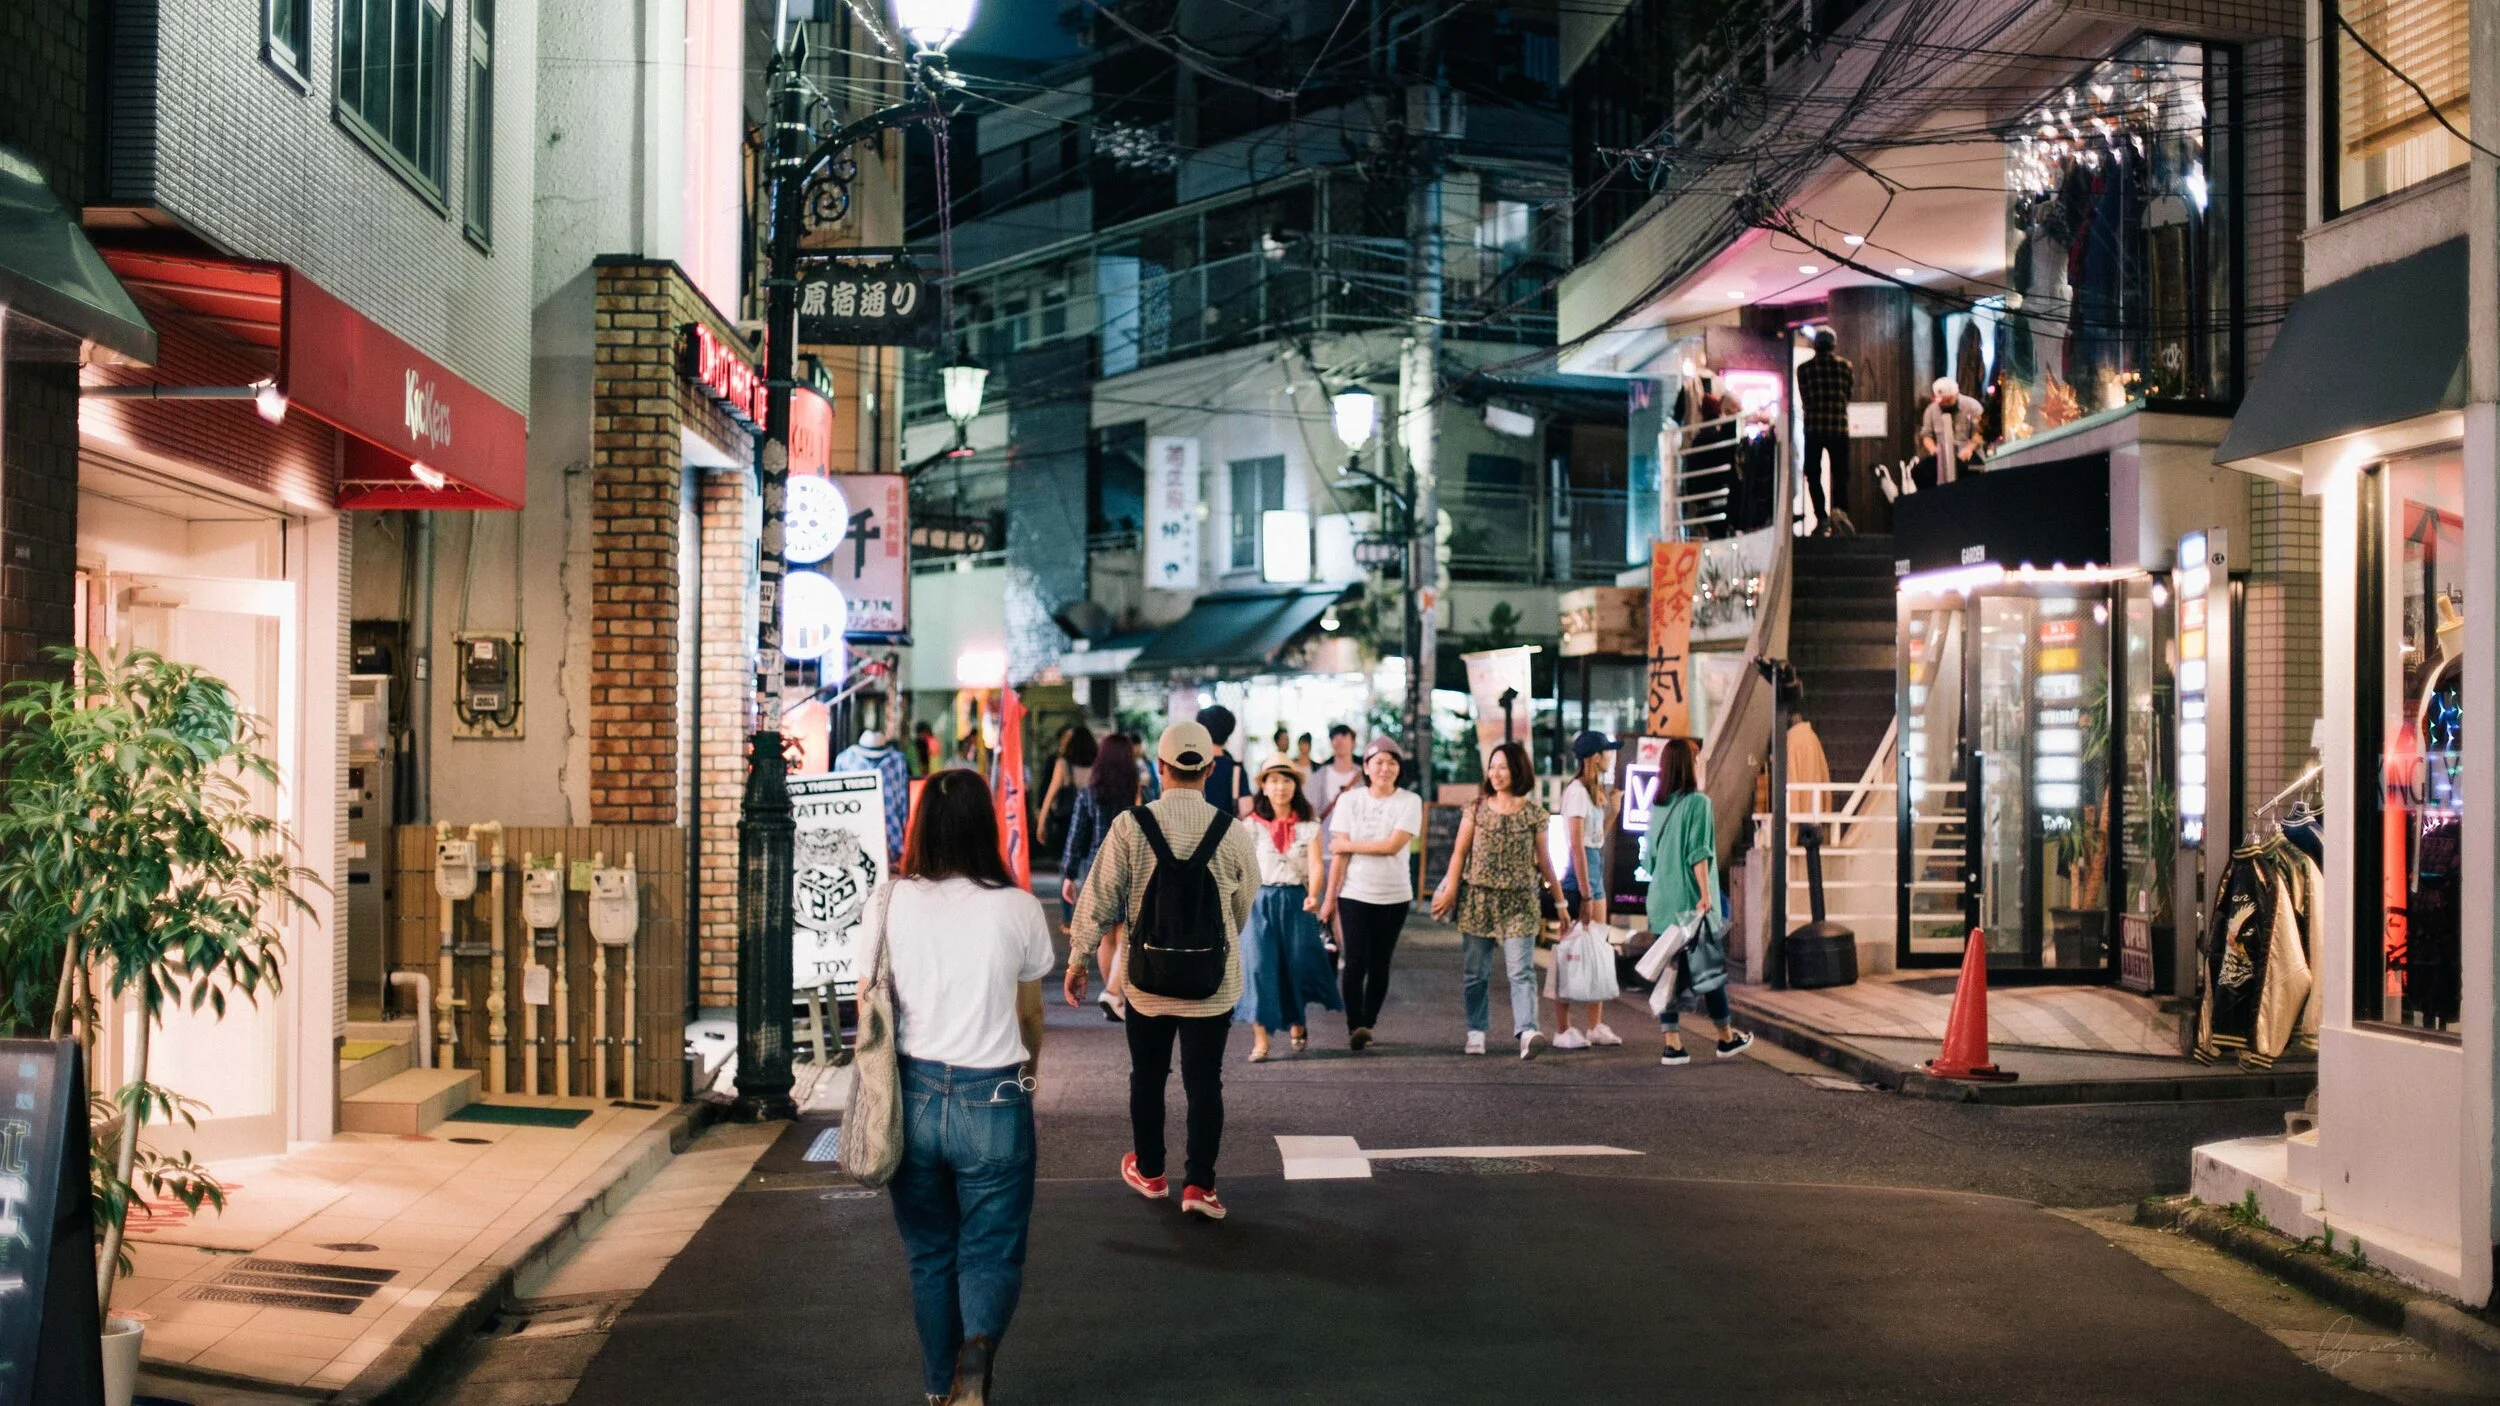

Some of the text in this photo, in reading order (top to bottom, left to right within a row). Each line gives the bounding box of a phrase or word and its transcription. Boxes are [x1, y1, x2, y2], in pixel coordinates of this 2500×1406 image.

[801, 280, 917, 317] 原宿通り
[793, 800, 861, 818] ATTOO
